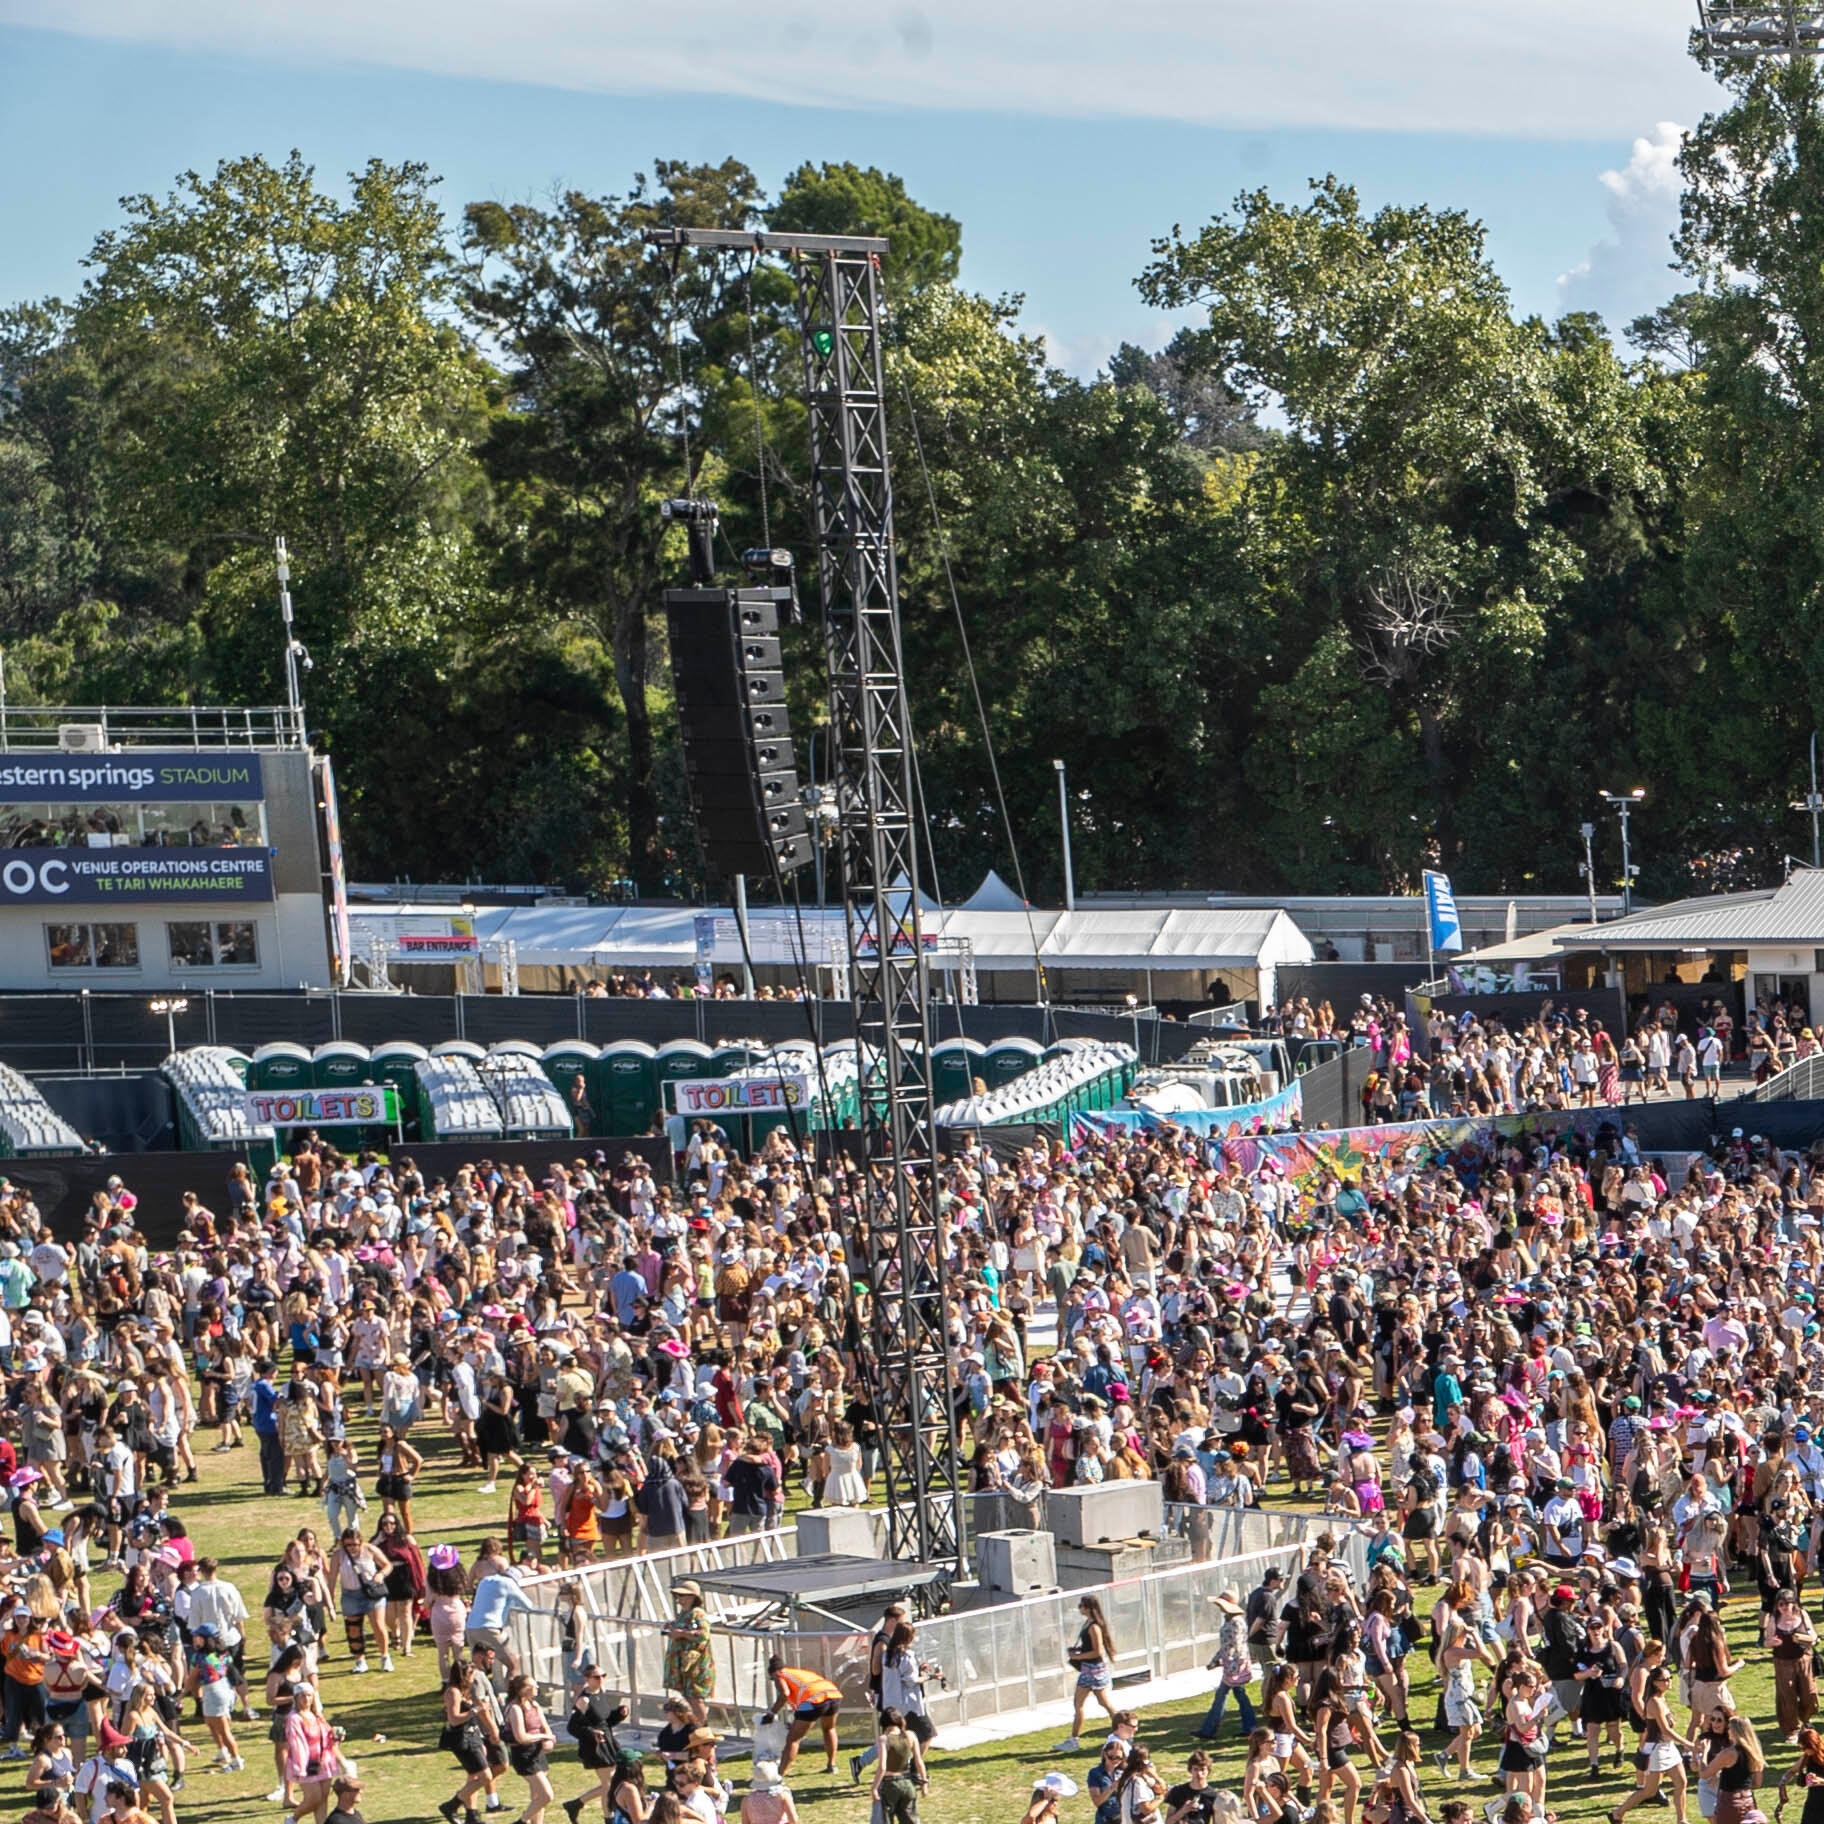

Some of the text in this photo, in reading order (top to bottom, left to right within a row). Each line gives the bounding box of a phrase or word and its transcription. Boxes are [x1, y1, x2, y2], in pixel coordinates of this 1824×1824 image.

[0, 763, 249, 790] stern springs STADIUM
[72, 859, 265, 874] VENUE OPERATIONS CENTRE
[96, 876, 244, 890] TE TARI WHAKAHAERE
[406, 941, 471, 952] BAR ENTRANCE
[686, 1082, 800, 1109] TOILETS
[254, 1095, 376, 1121] TOILETS
